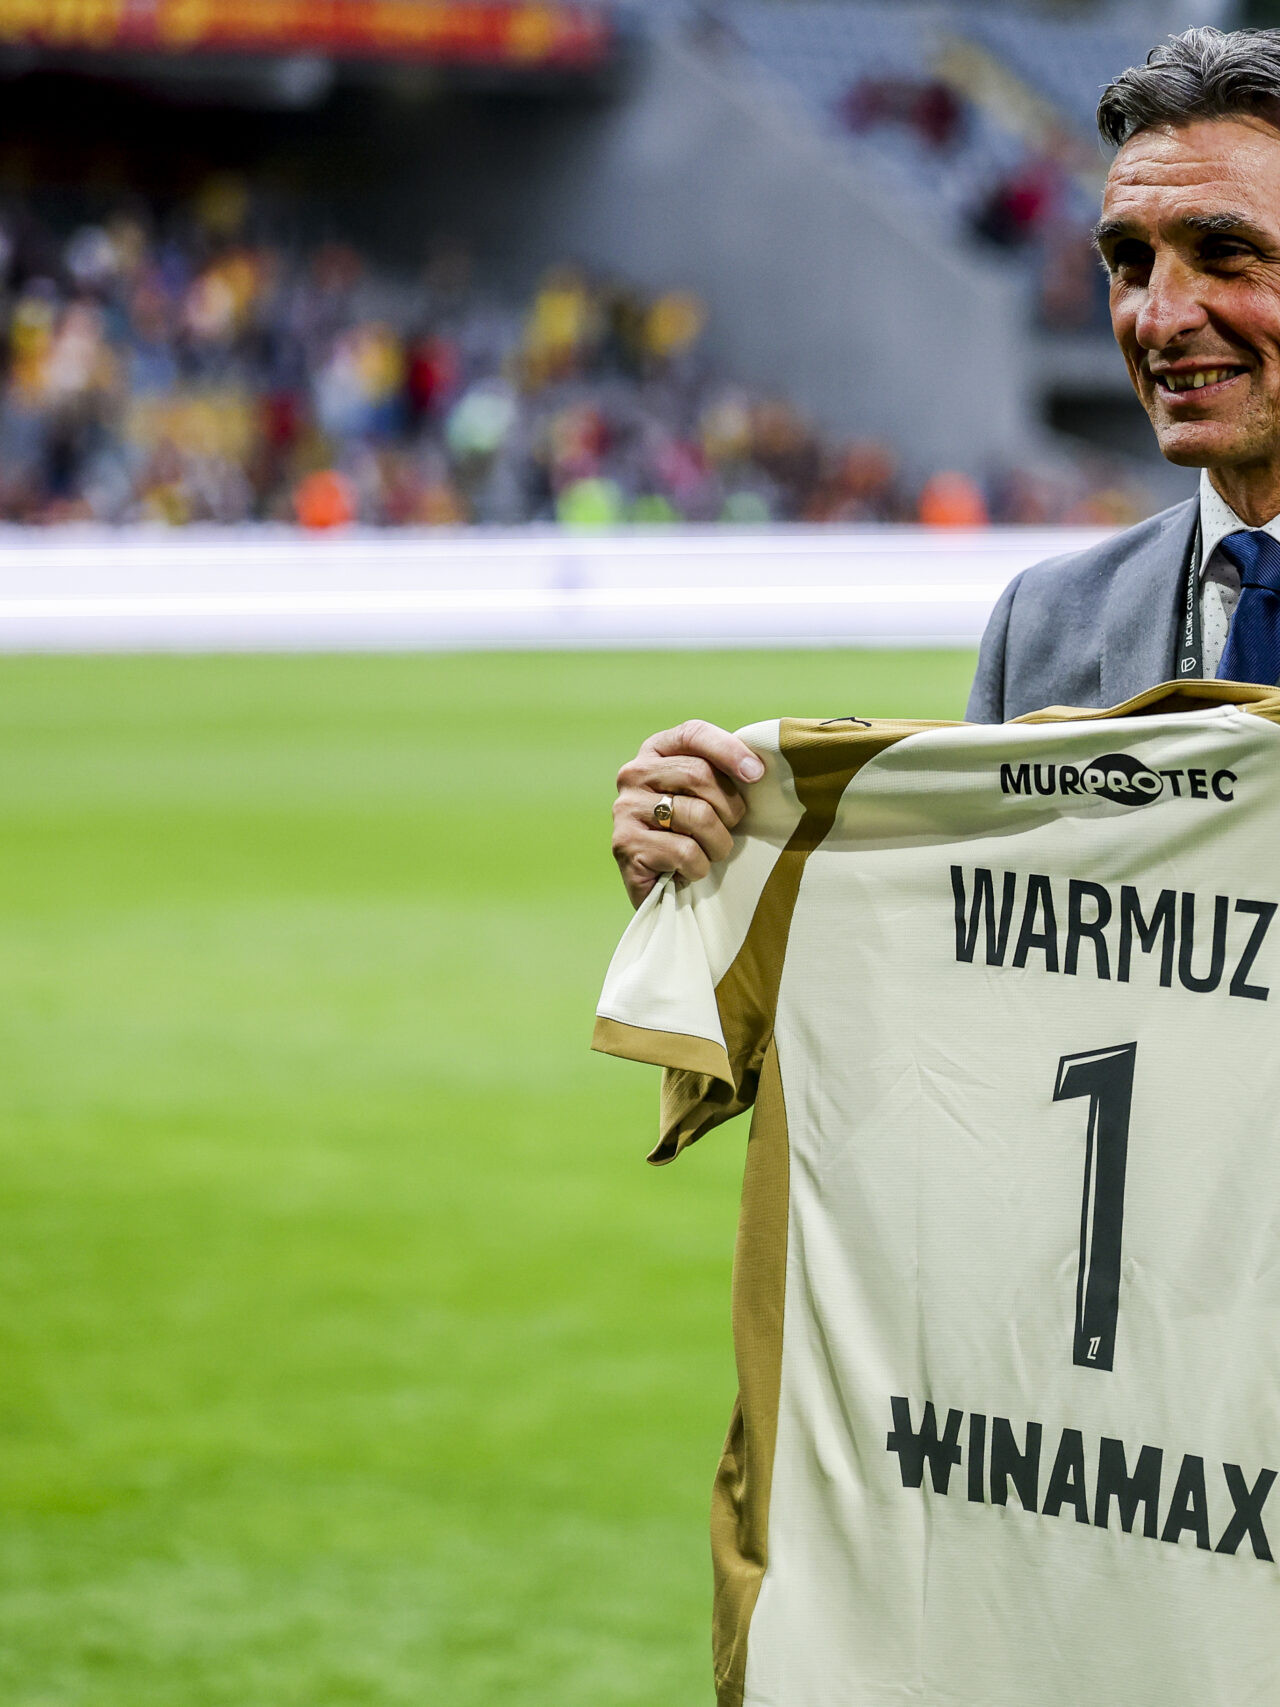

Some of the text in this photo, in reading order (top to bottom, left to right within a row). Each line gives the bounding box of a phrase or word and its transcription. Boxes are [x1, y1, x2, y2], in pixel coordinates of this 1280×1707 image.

[1186, 587, 1194, 611] CLUB
[1187, 573, 1195, 587] DE
[1185, 612, 1194, 647] RACING
[1000, 756, 1238, 804] MURPROTEC
[950, 865, 1278, 1001] WARMUZ
[1053, 1041, 1137, 1372] 1
[887, 1396, 1279, 1562] WINAMAX
